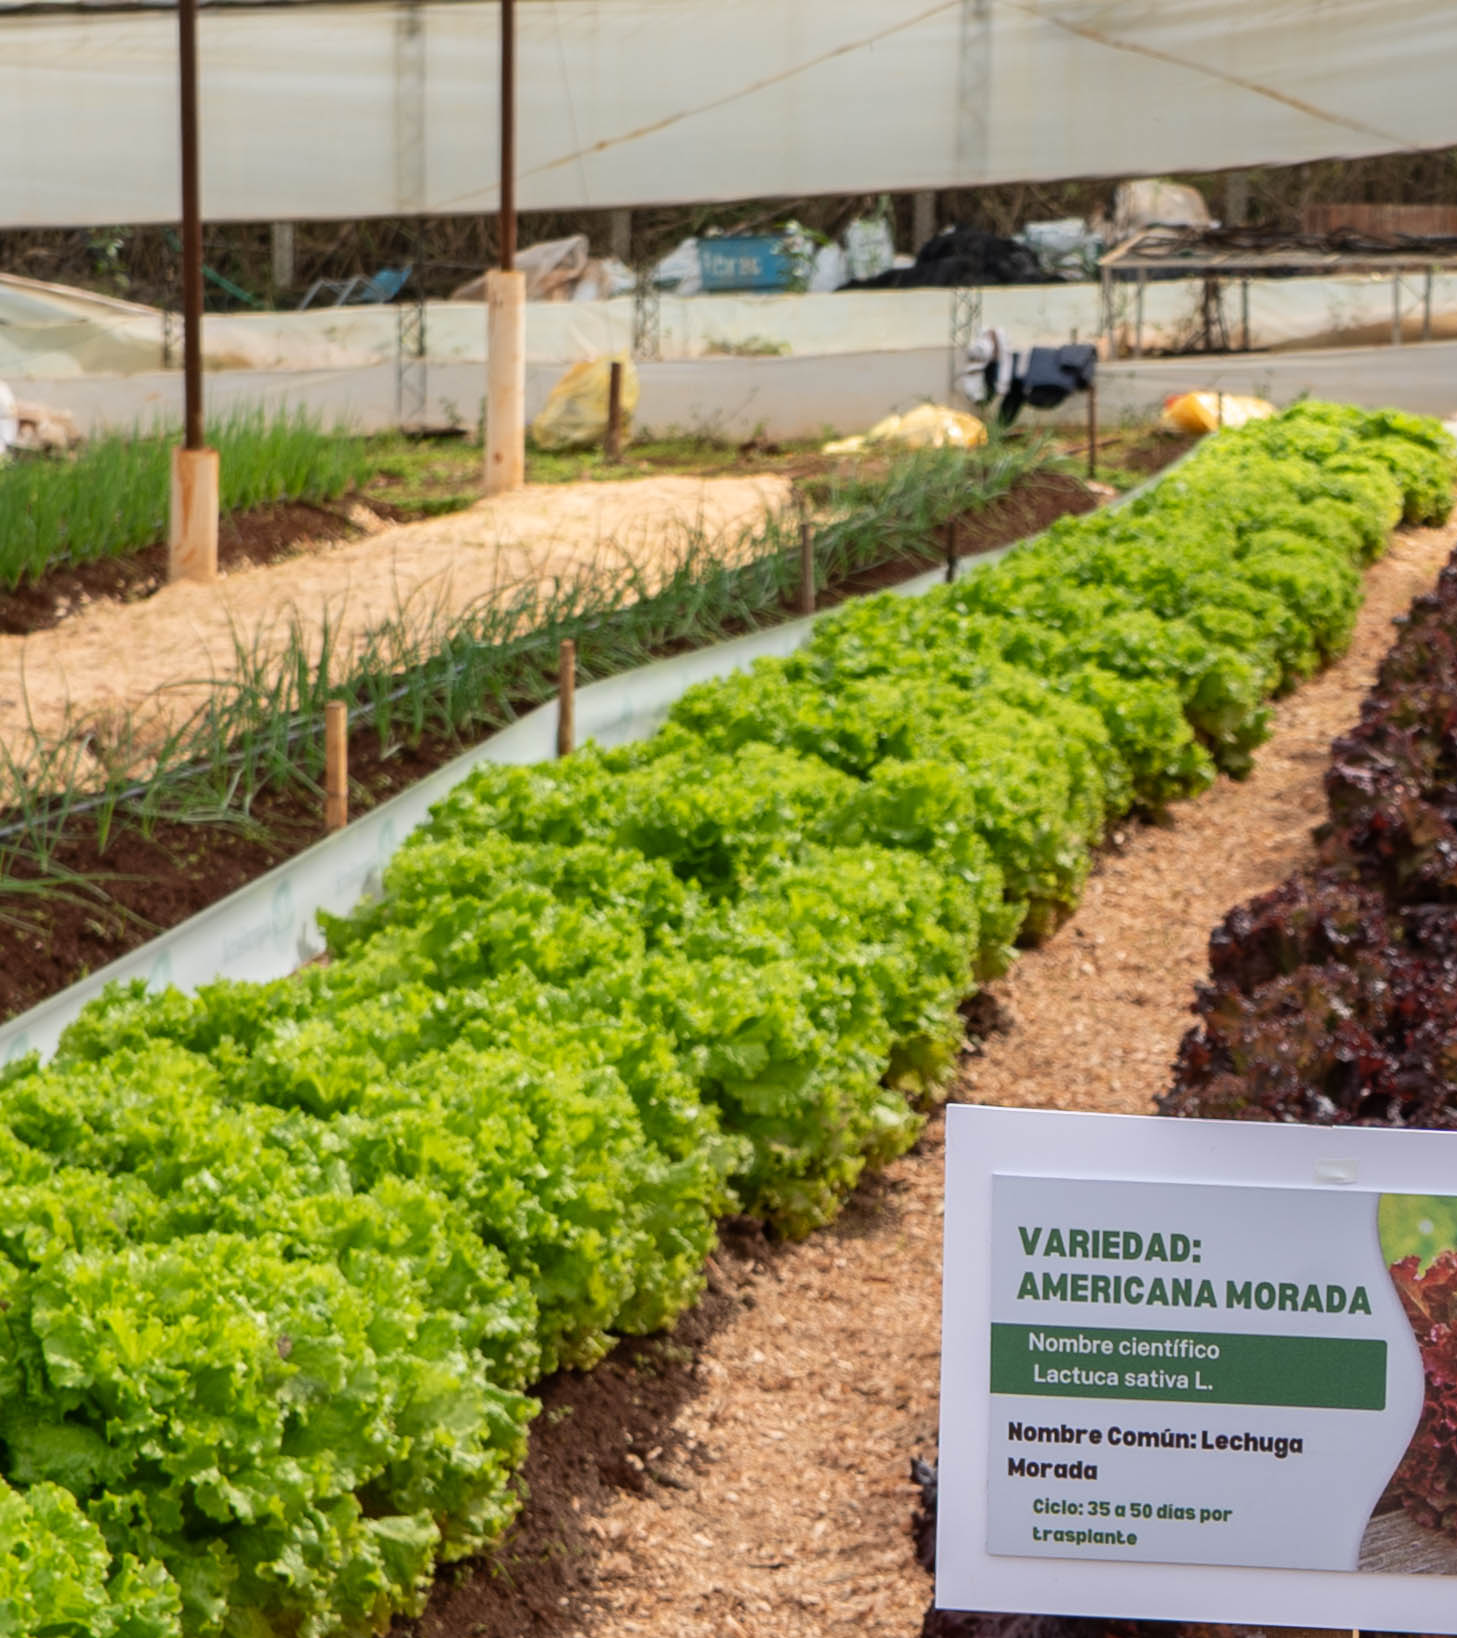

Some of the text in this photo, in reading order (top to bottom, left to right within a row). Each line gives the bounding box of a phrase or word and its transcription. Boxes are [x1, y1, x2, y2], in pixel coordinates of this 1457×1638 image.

[1017, 1226, 1202, 1264] VARIEDAD:
[1016, 1271, 1373, 1316] AMERICANA MORADA
[1028, 1332, 1222, 1360] Nombre científico
[1033, 1363, 1214, 1391] Lactuca sativa L.
[1008, 1421, 1303, 1459] Nombre Común: Lechuga
[1007, 1457, 1098, 1481] Morada
[1032, 1497, 1233, 1526] Ciclo: 35 a 50 días por
[1032, 1526, 1138, 1546] trasplante
